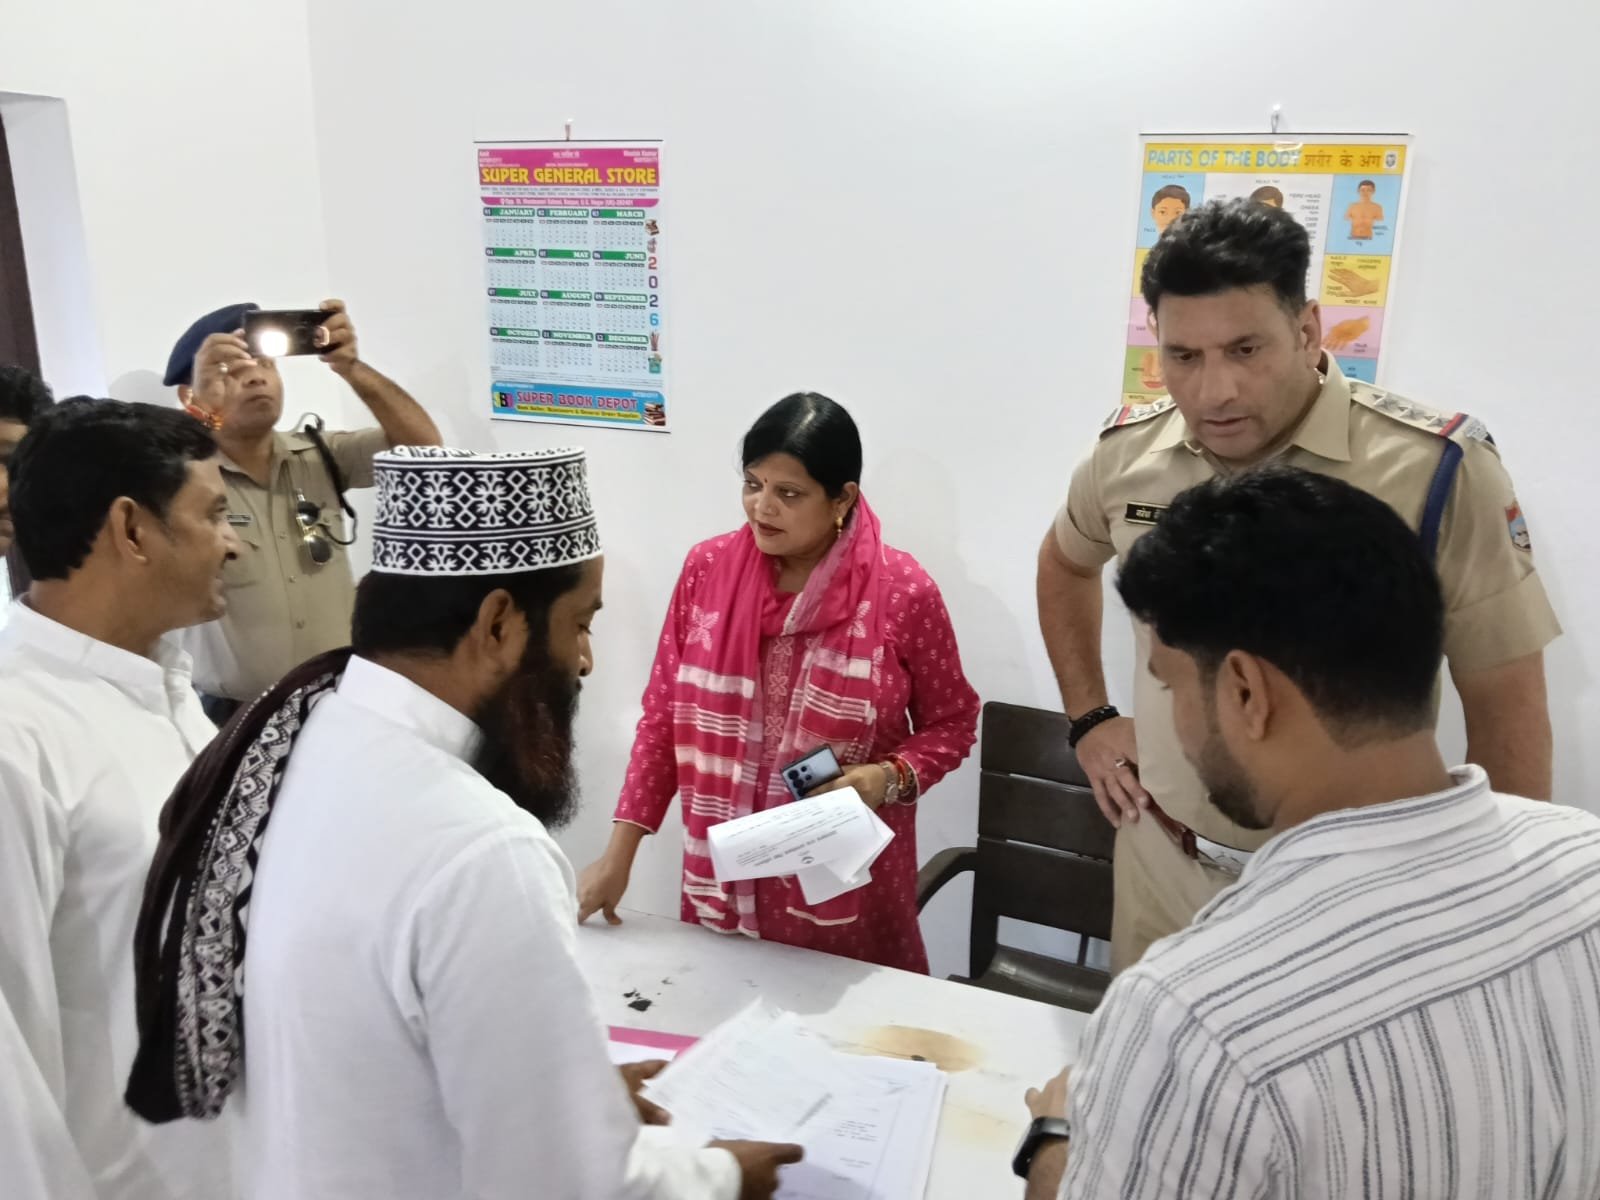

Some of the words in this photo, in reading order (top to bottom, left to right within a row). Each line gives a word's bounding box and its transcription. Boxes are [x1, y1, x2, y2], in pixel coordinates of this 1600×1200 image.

[1147, 150, 1192, 164] PARTS
[1198, 150, 1219, 165] OF
[1224, 151, 1250, 166] THE
[1256, 151, 1302, 167] BODY
[1304, 150, 1333, 167] शरीर
[1339, 150, 1353, 167] के
[1359, 150, 1381, 168] अंग
[481, 168, 529, 184] SUPER
[534, 168, 602, 184] GENERAL
[607, 168, 656, 184] STORE
[561, 292, 591, 300] AUGUST
[603, 294, 646, 302] SEPTEMBER
[507, 329, 539, 337] OCTOBER
[552, 332, 592, 340] NOVEMBER
[608, 334, 647, 343] DECEMBER
[517, 391, 554, 404] SUPER
[559, 394, 592, 406] BOOK
[598, 397, 637, 410] DEPOT
